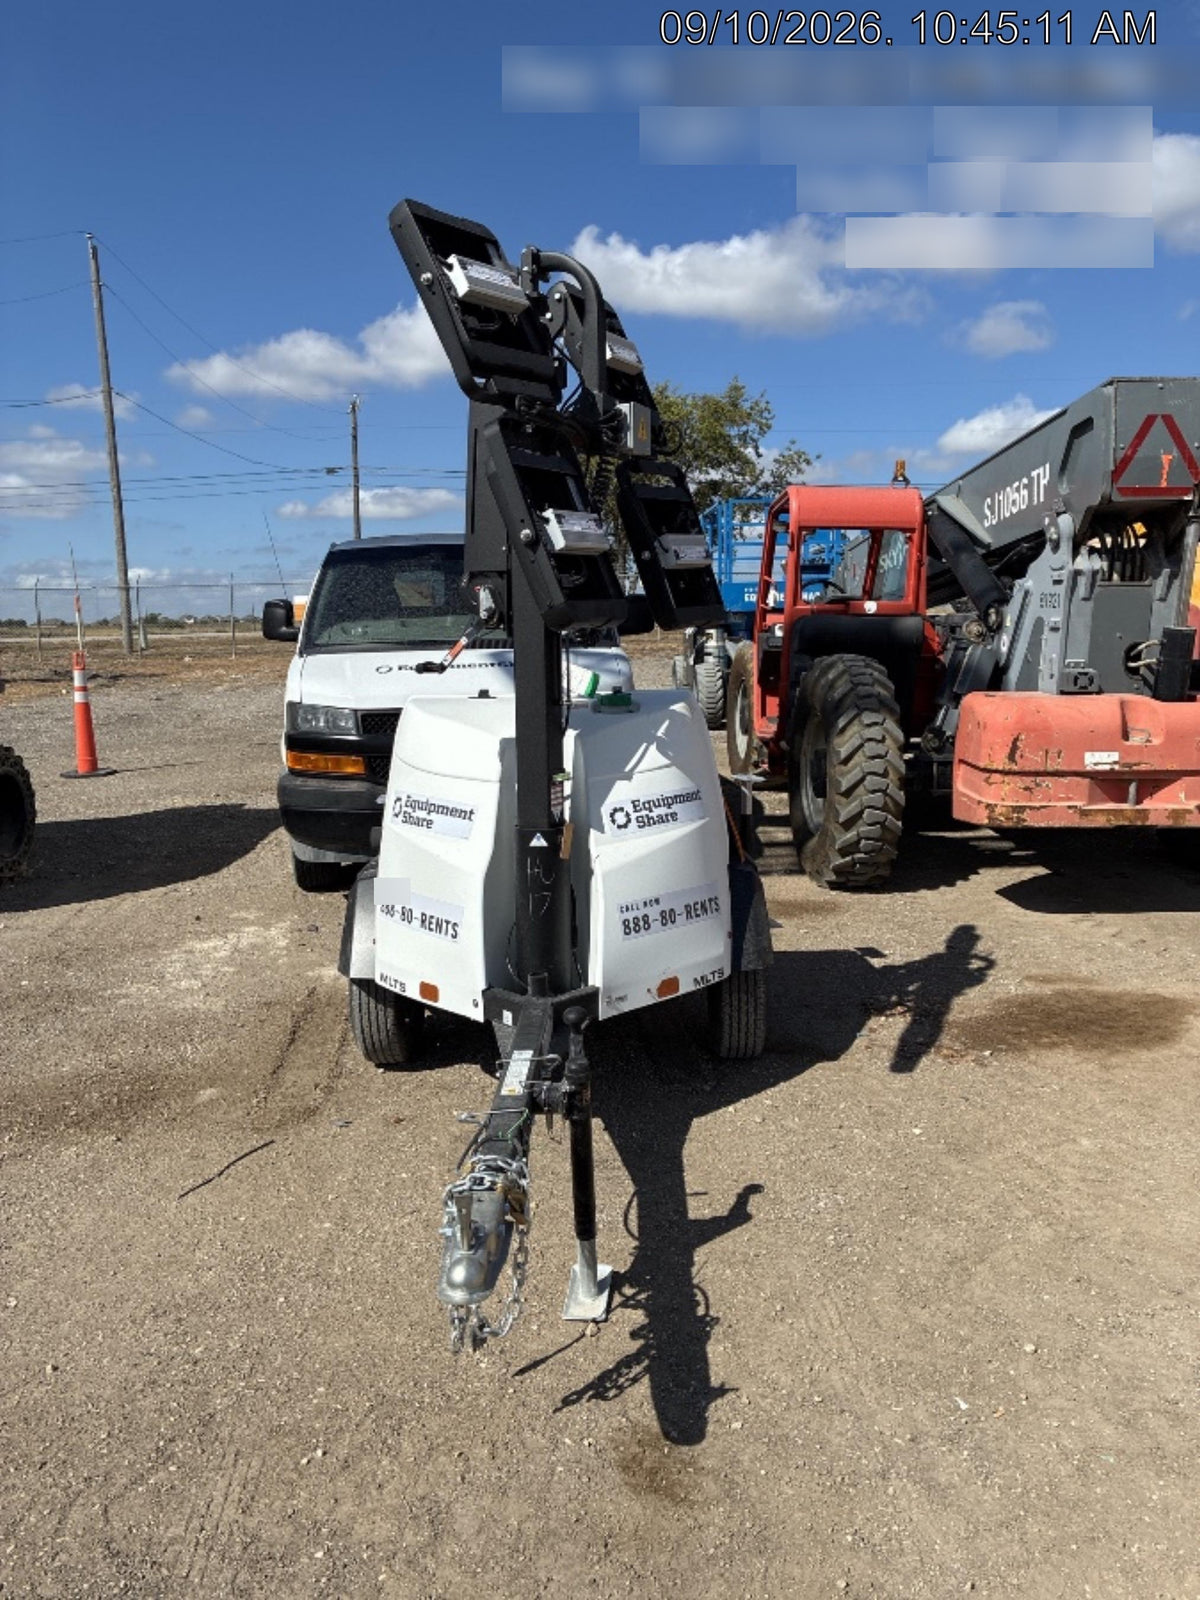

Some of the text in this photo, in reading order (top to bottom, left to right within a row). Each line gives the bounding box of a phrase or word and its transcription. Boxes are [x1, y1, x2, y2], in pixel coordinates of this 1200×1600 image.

[983, 476, 1029, 528] SJ1056
[404, 794, 475, 822] Equipment
[630, 788, 702, 814] Equipment
[401, 810, 434, 830] Share
[635, 811, 679, 829] Share
[622, 896, 720, 936] 888-80-RENTS
[380, 972, 406, 993] MLTS
[693, 966, 724, 988] MLTS
